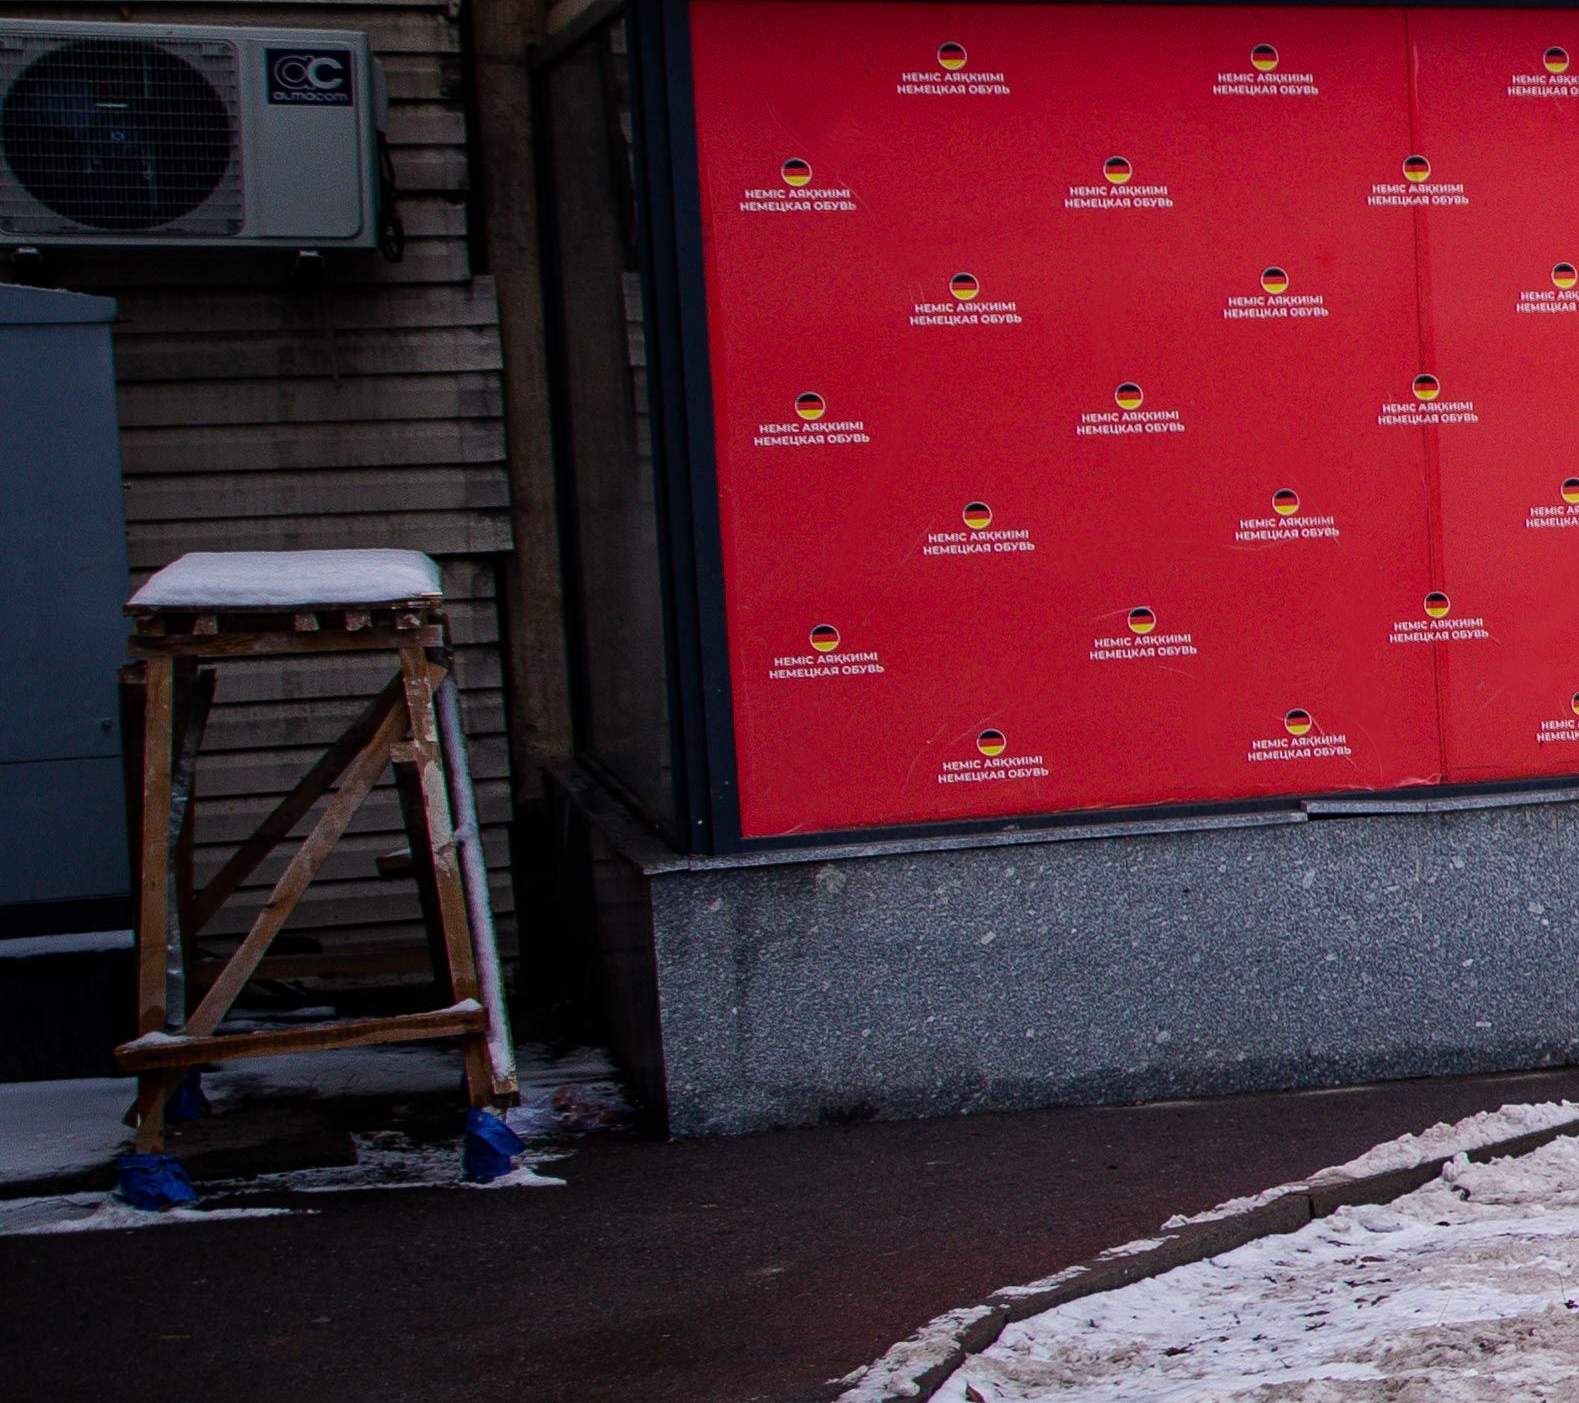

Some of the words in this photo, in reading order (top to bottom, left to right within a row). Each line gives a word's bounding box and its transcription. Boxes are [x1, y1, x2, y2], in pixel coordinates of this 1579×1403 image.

[902, 71, 942, 82] НЕМІС
[1217, 73, 1254, 84] НЕМІС
[896, 84, 966, 96] НЕМЕЦКАЯ
[968, 84, 1011, 96] ОБУВЬ
[1212, 84, 1278, 96] НЕМЕЦКАЯ
[1279, 83, 1319, 95] ОБУВЬ
[1507, 86, 1568, 98] НЕМЕЦКАЯ
[744, 189, 786, 200] НЕМІС
[1069, 186, 1107, 197] НЕМІС
[739, 200, 812, 212] НЕМЕЦКАЯ
[813, 200, 857, 211] ОБУВЬ
[1064, 197, 1131, 209] НЕМЕЦКАЯ
[1133, 196, 1174, 208] ОБУВЬ
[1367, 194, 1430, 206] НЕМЕЦКАЯ
[1431, 195, 1470, 206] ОБУВЬ
[914, 302, 954, 314] НЕМІС
[1228, 296, 1265, 308] НЕМІС
[1516, 302, 1577, 314] НЕМЕЦКАЯ
[1223, 307, 1288, 320] НЕМЕЦКАЯ
[1290, 305, 1329, 317] ОБУВЬ
[909, 314, 979, 327] НЕМЕЦКАЯ
[980, 312, 1023, 324] ОБУВЬ
[1081, 412, 1119, 424] НЕМІС
[1377, 413, 1439, 425] НЕМЕЦКАЯ
[1440, 412, 1479, 424] ОБУВЬ
[759, 422, 799, 434] НЕМІС
[1076, 423, 1143, 436] НЕМЕЦКАЯ
[1145, 421, 1186, 433] ОБУВЬ
[753, 434, 825, 447] НЕМЕЦКАЯ
[827, 432, 870, 444] ОБУВЬ
[1239, 517, 1276, 529] НЕМІС
[928, 531, 967, 543] НЕМІС
[1235, 529, 1299, 542] НЕМЕЦКАЯ
[1301, 526, 1340, 538] ОБУВЬ
[923, 543, 992, 556] НЕМЕЦКАЯ
[993, 540, 1036, 552] ОБУВЬ
[1094, 636, 1132, 648] НЕМІС
[1389, 631, 1450, 644] НЕМЕЦКАЯ
[1451, 628, 1490, 640] ОБУВЬ
[1089, 648, 1156, 662] НЕМЕЦКАЯ
[1157, 645, 1198, 657] ОБУВЬ
[774, 654, 814, 666] НЕМІС
[769, 666, 840, 680] НЕМЕЦКАЯ
[841, 662, 885, 674] ОБУВЬ
[1252, 737, 1289, 749] НЕМІС
[1247, 749, 1312, 763] НЕМЕЦКАЯ
[1313, 745, 1352, 757] ОБУВЬ
[942, 759, 981, 771] НЕМІС
[937, 770, 1006, 784] НЕМЕЦКАЯ
[1008, 766, 1050, 778] ОБУВЬ
